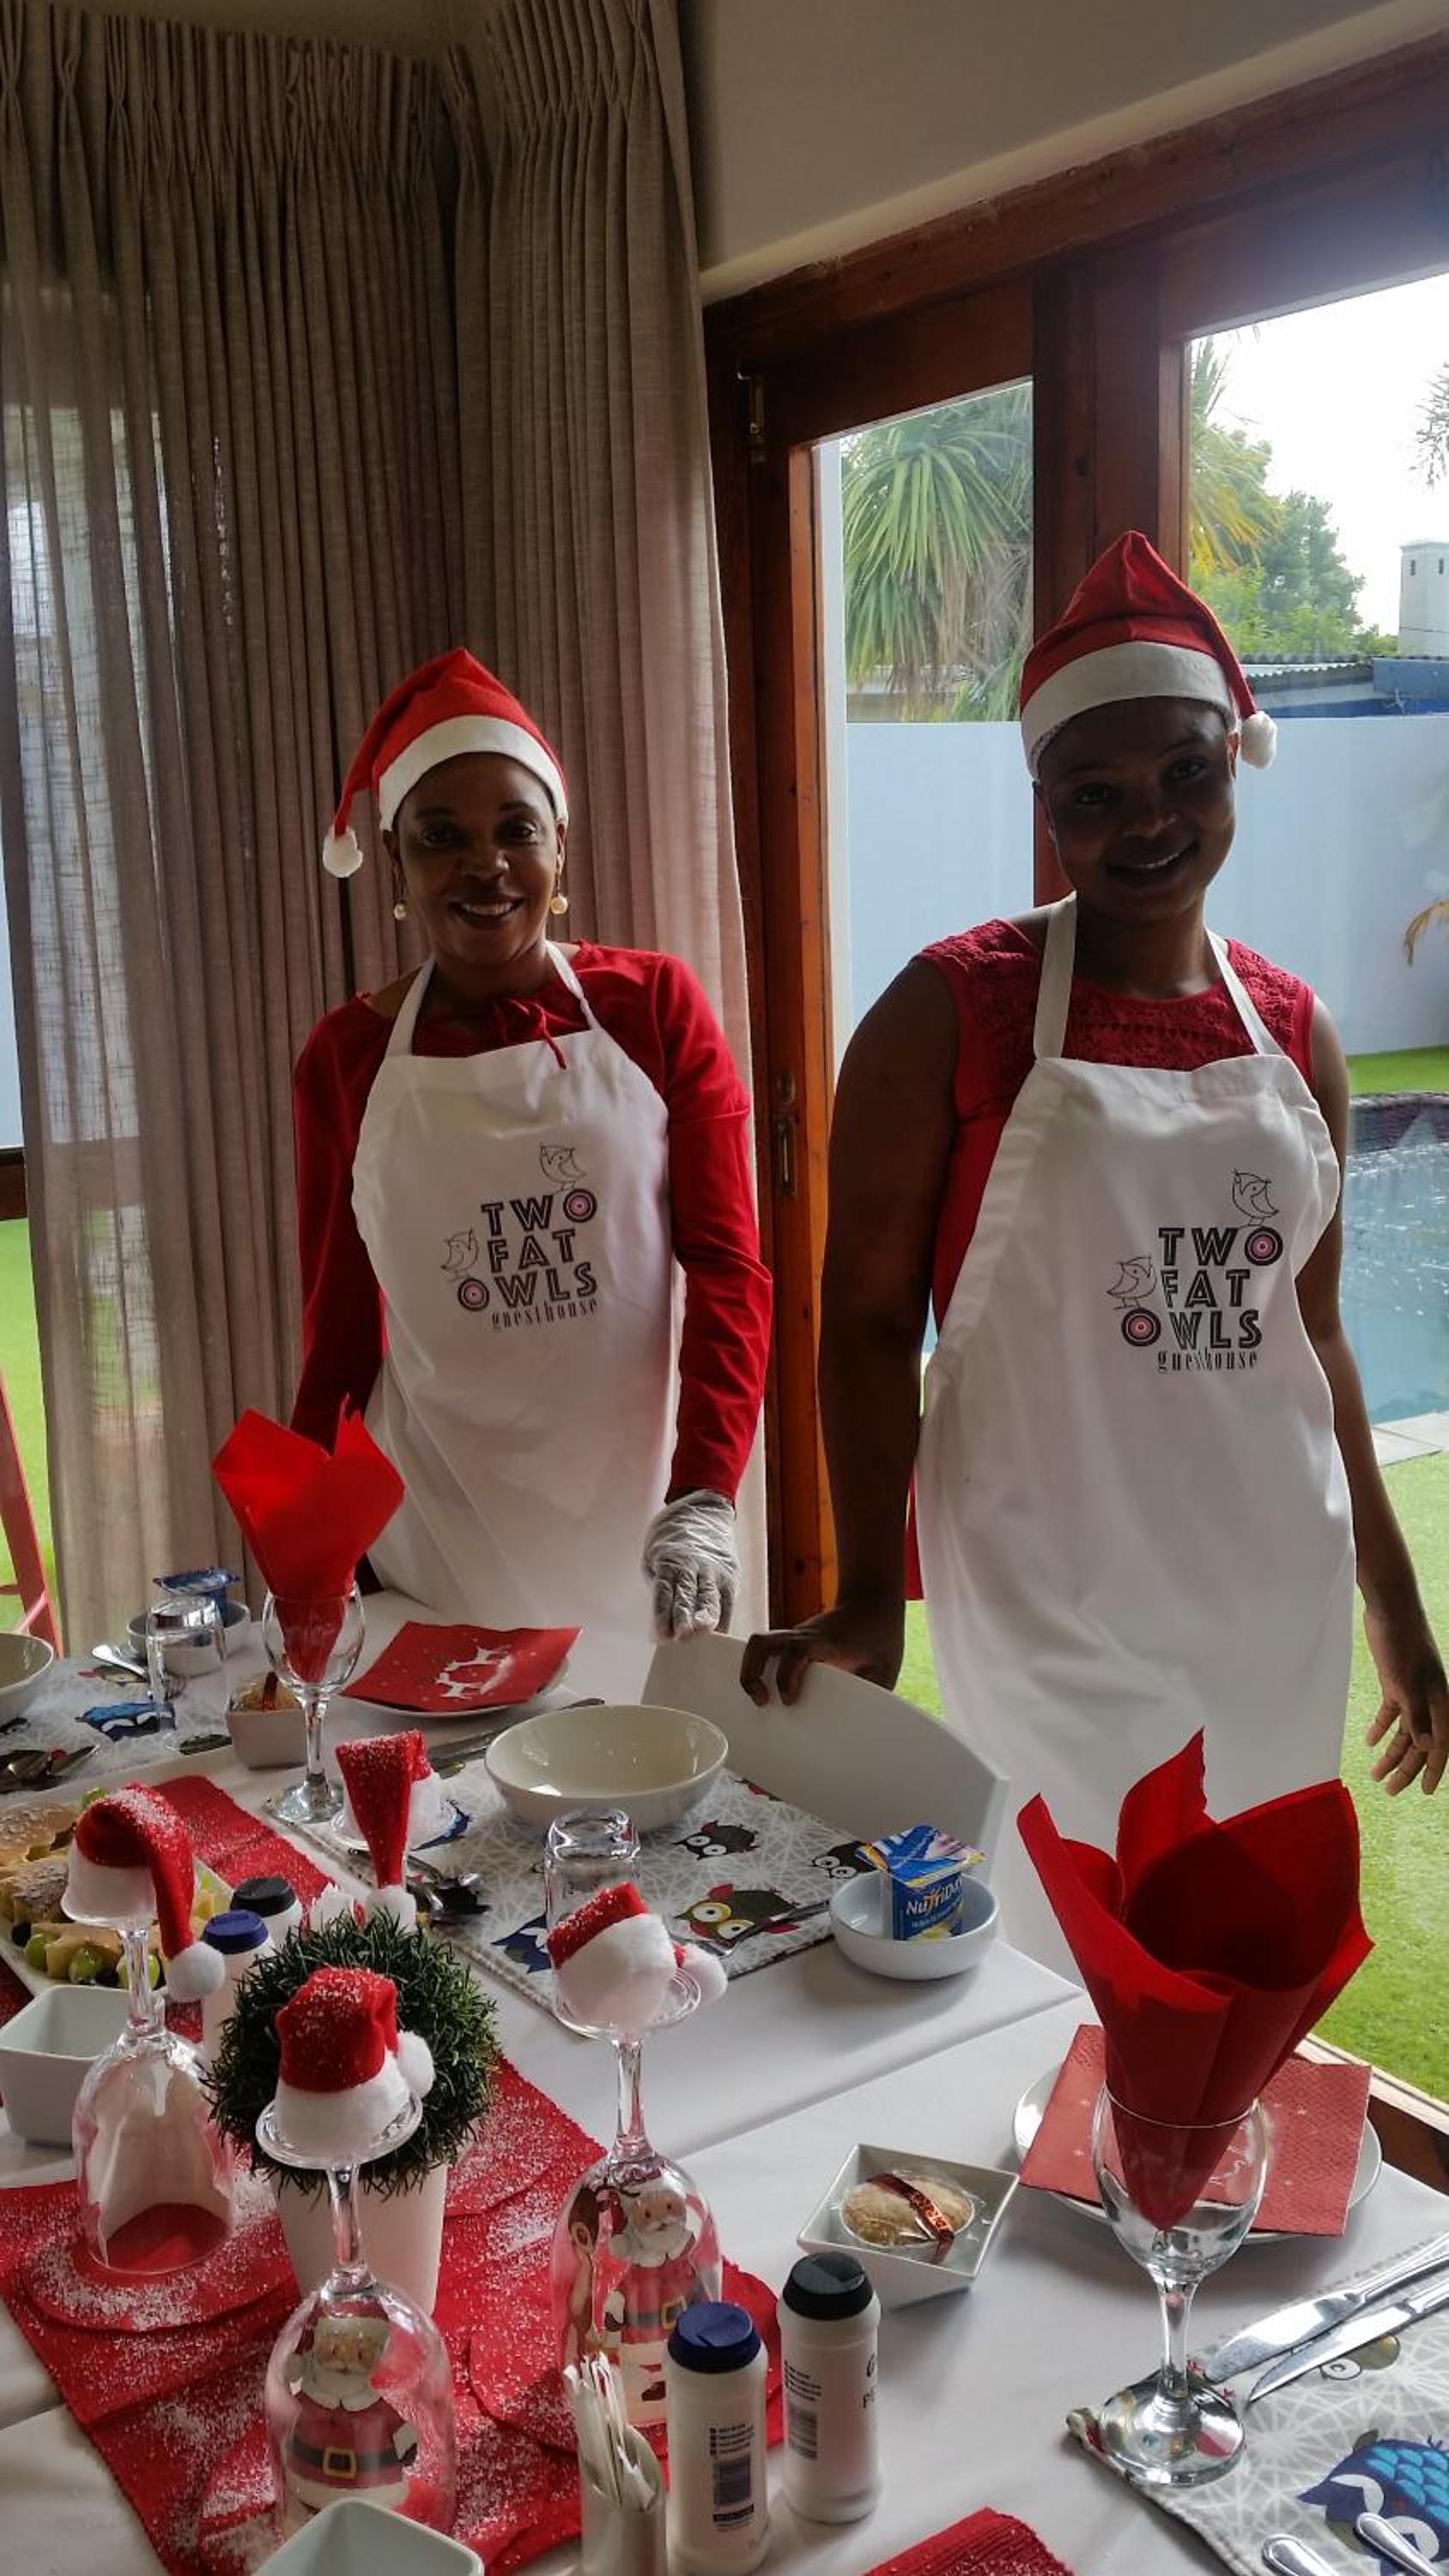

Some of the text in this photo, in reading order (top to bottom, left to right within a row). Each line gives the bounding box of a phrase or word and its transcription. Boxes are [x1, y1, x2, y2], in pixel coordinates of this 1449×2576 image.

[482, 1188, 597, 1236] TWO
[487, 1229, 576, 1273] FAT
[1159, 1226, 1283, 1266] TWO
[458, 1262, 598, 1311] OWLS
[1161, 1268, 1250, 1308] FAT
[492, 1299, 598, 1330] guesthouse
[1121, 1308, 1263, 1349] OWLS
